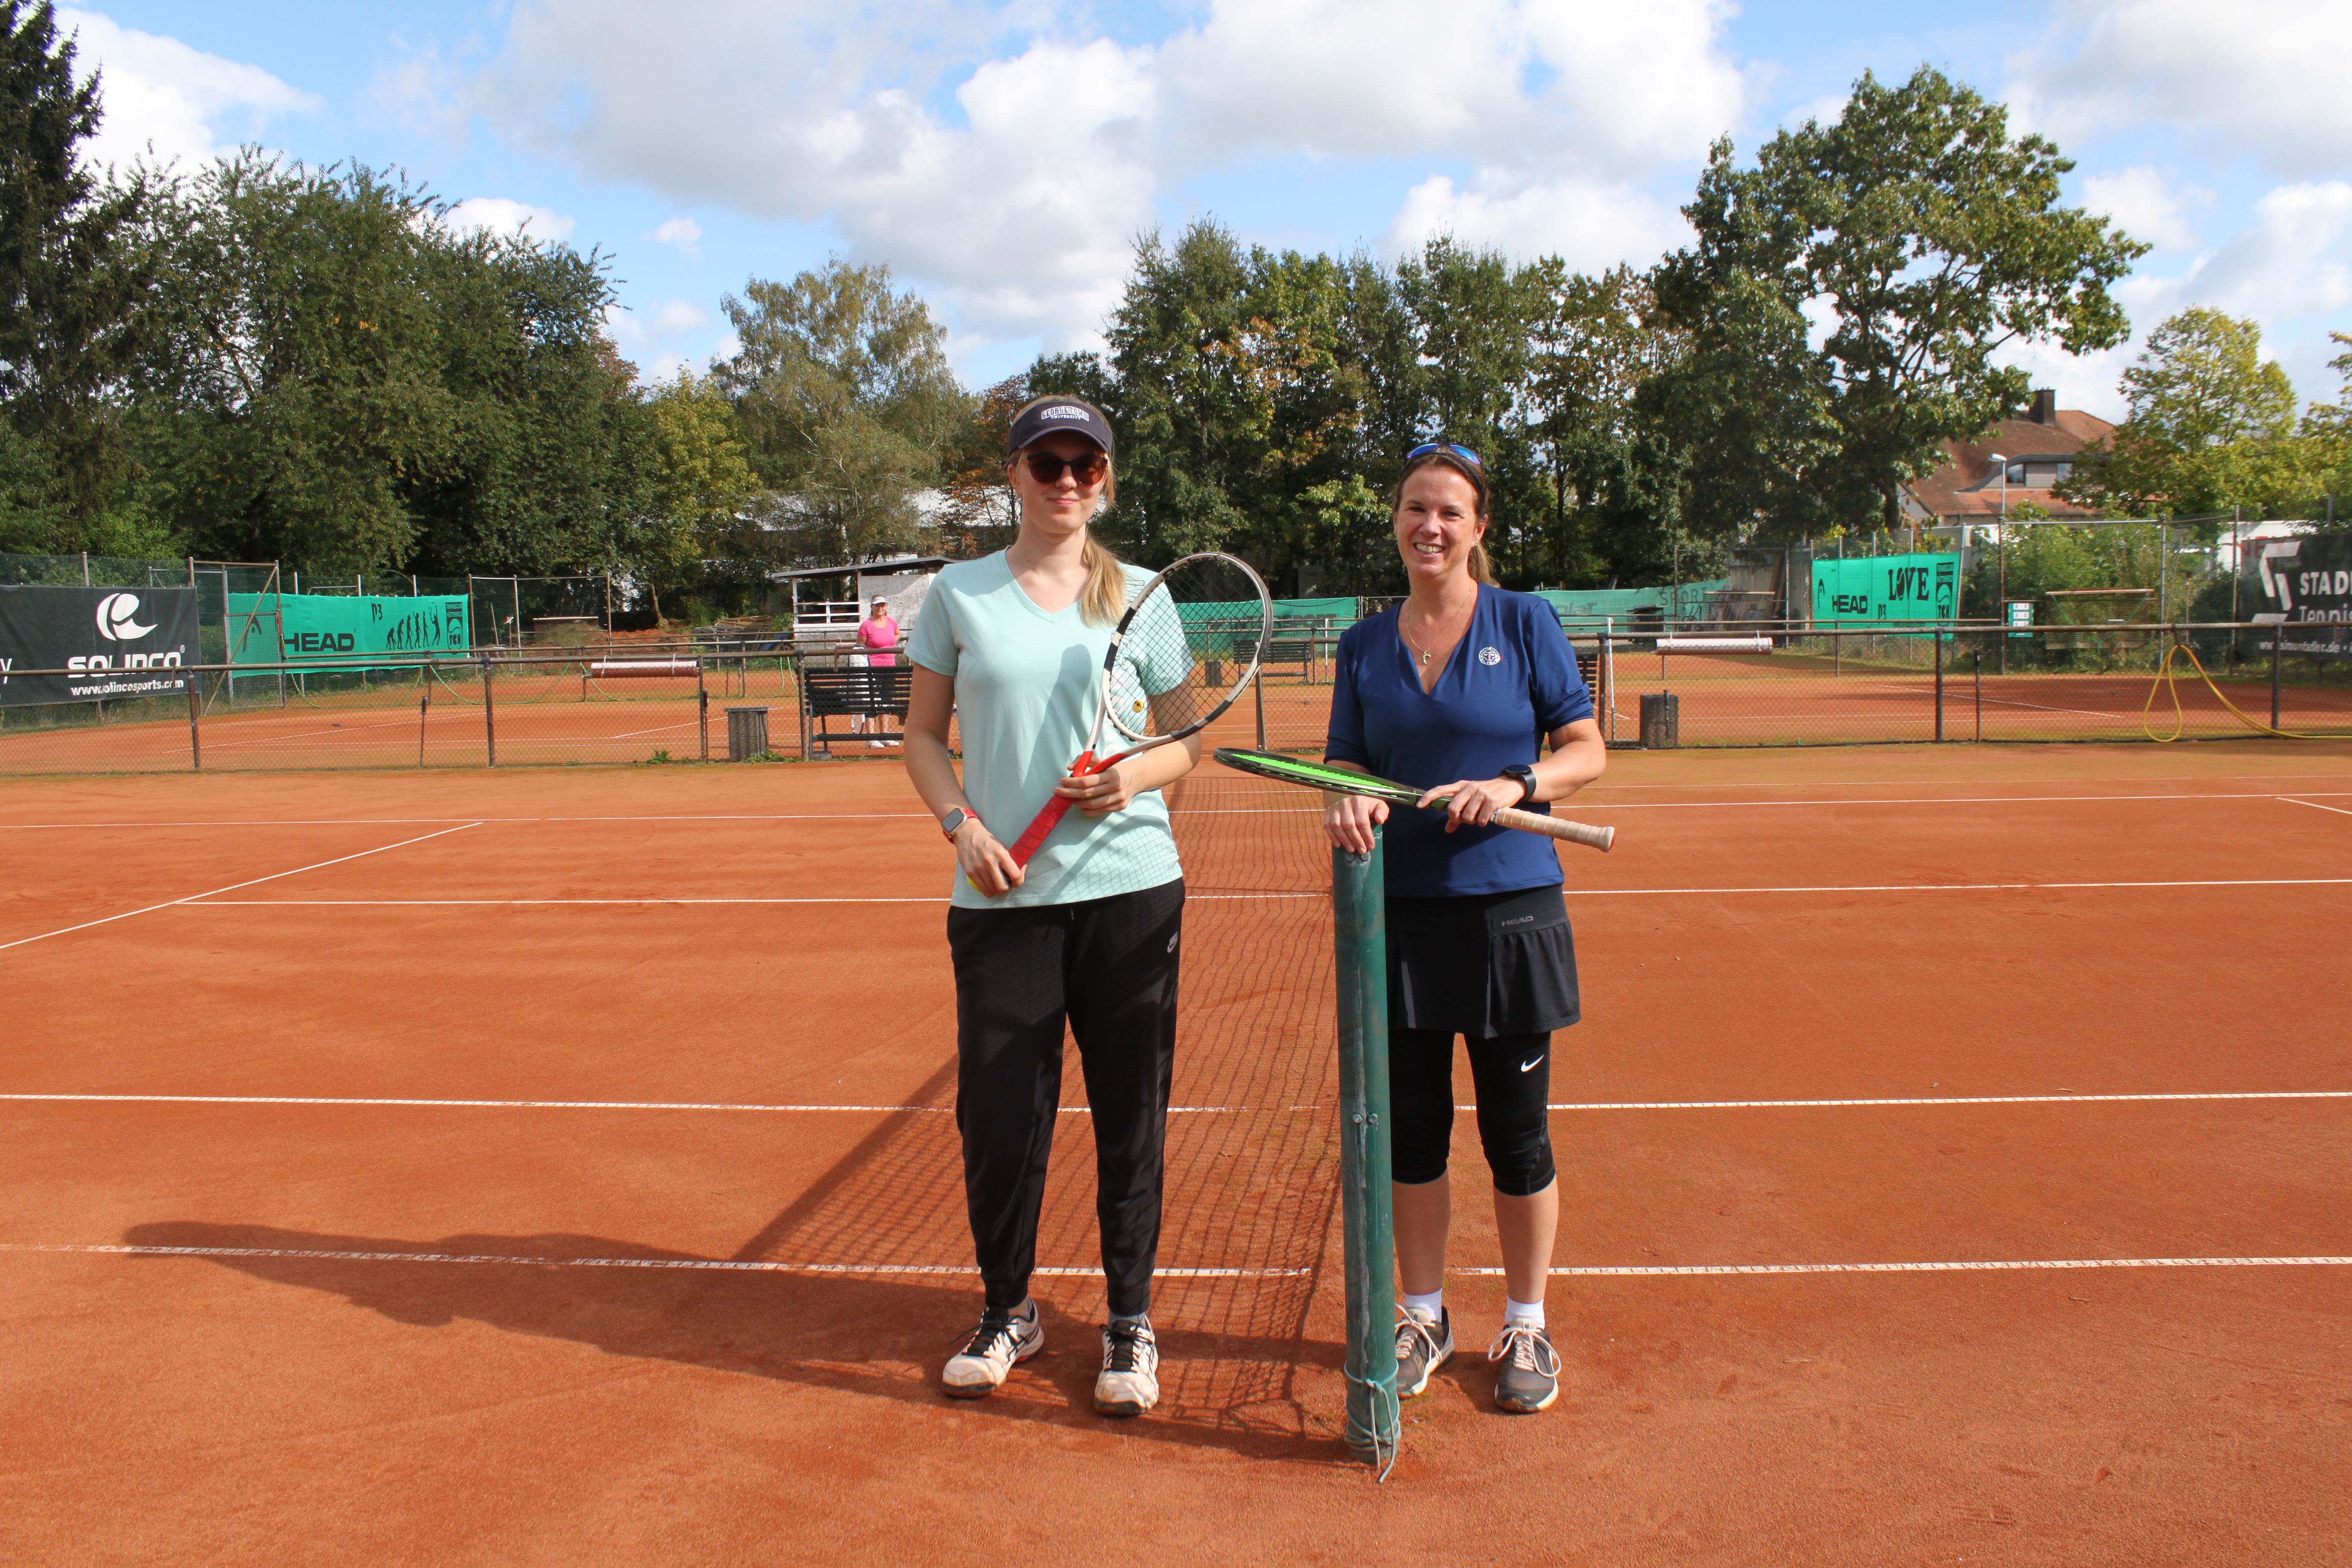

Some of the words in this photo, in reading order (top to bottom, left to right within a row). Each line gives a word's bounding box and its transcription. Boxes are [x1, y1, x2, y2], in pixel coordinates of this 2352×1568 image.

[1041, 406, 1089, 422] GEORGETOWN
[1888, 567, 1929, 601] LOVE
[2300, 571, 2352, 595] STAD
[1832, 595, 1867, 614] HEAD
[282, 633, 354, 651] HEAD
[449, 634, 461, 645] TCH
[68, 652, 181, 678] SOLINCO
[1501, 915, 1533, 926] HEAD
